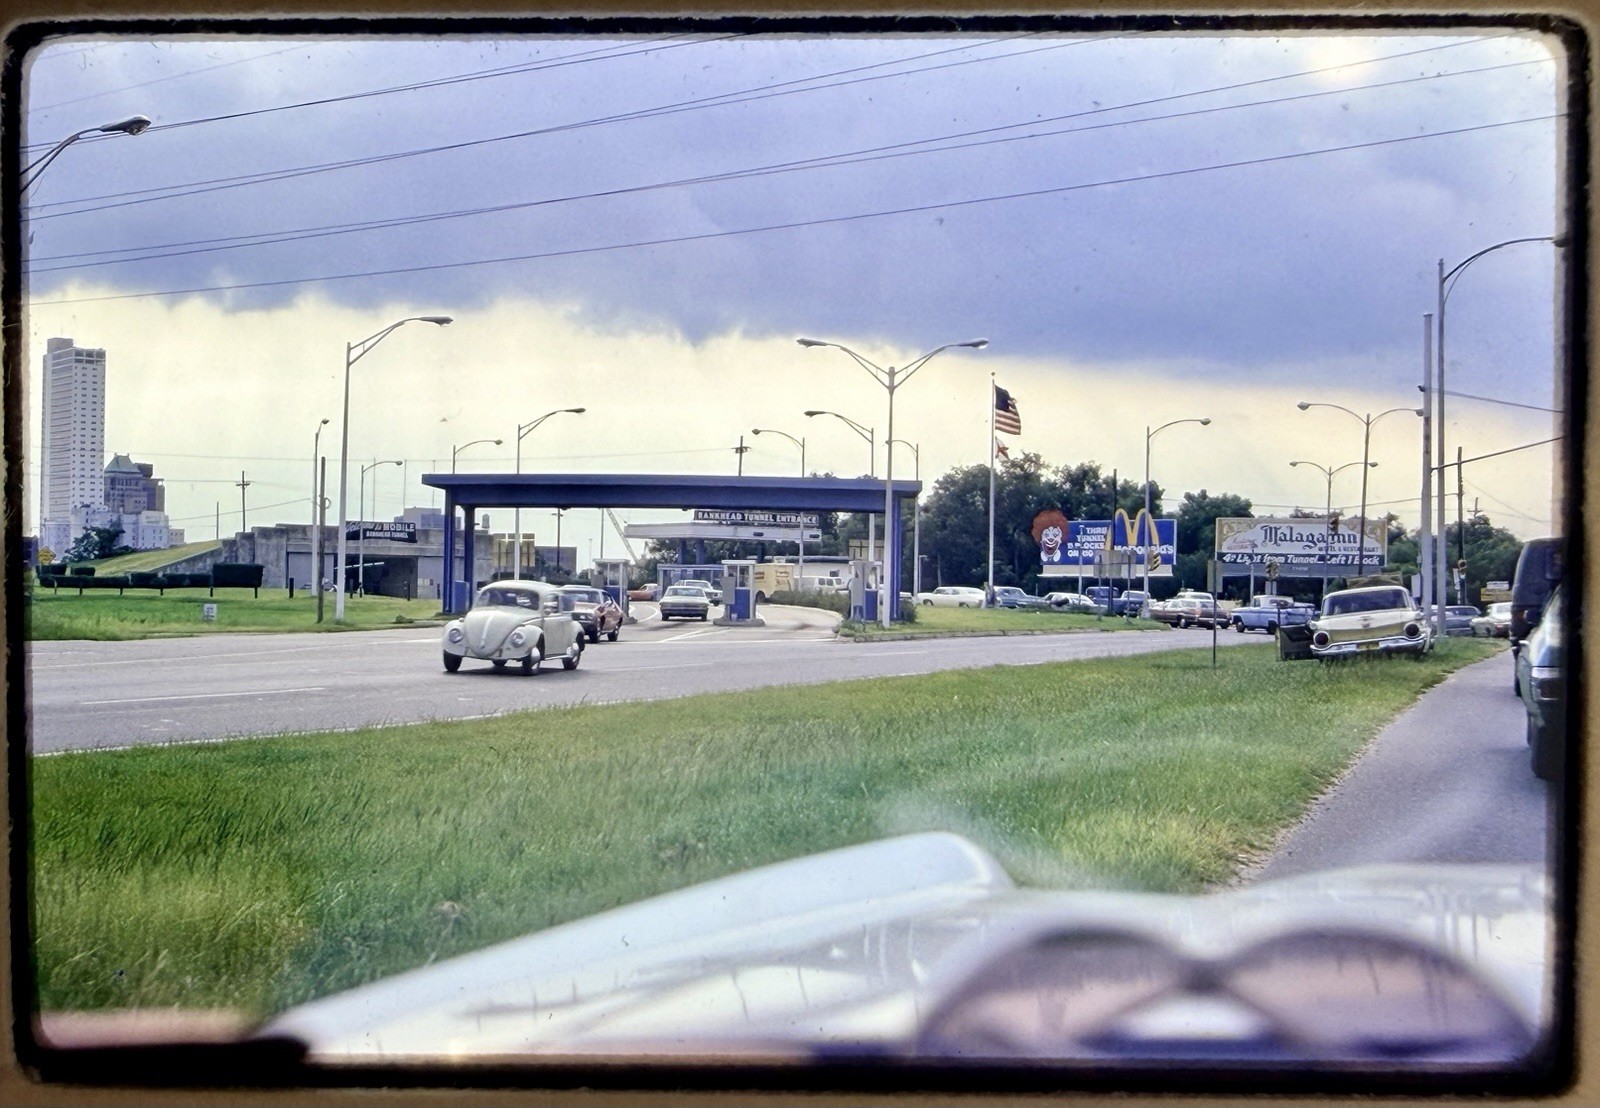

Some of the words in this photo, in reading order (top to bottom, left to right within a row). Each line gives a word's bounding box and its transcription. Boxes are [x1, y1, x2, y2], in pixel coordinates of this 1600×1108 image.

[697, 511, 742, 520] BANKHEAD
[744, 513, 774, 522] TUNNEL
[776, 515, 817, 524] ENTRANCE
[383, 523, 415, 532] MOBILE
[1085, 527, 1107, 535] THRU
[1260, 524, 1327, 550] Malaga
